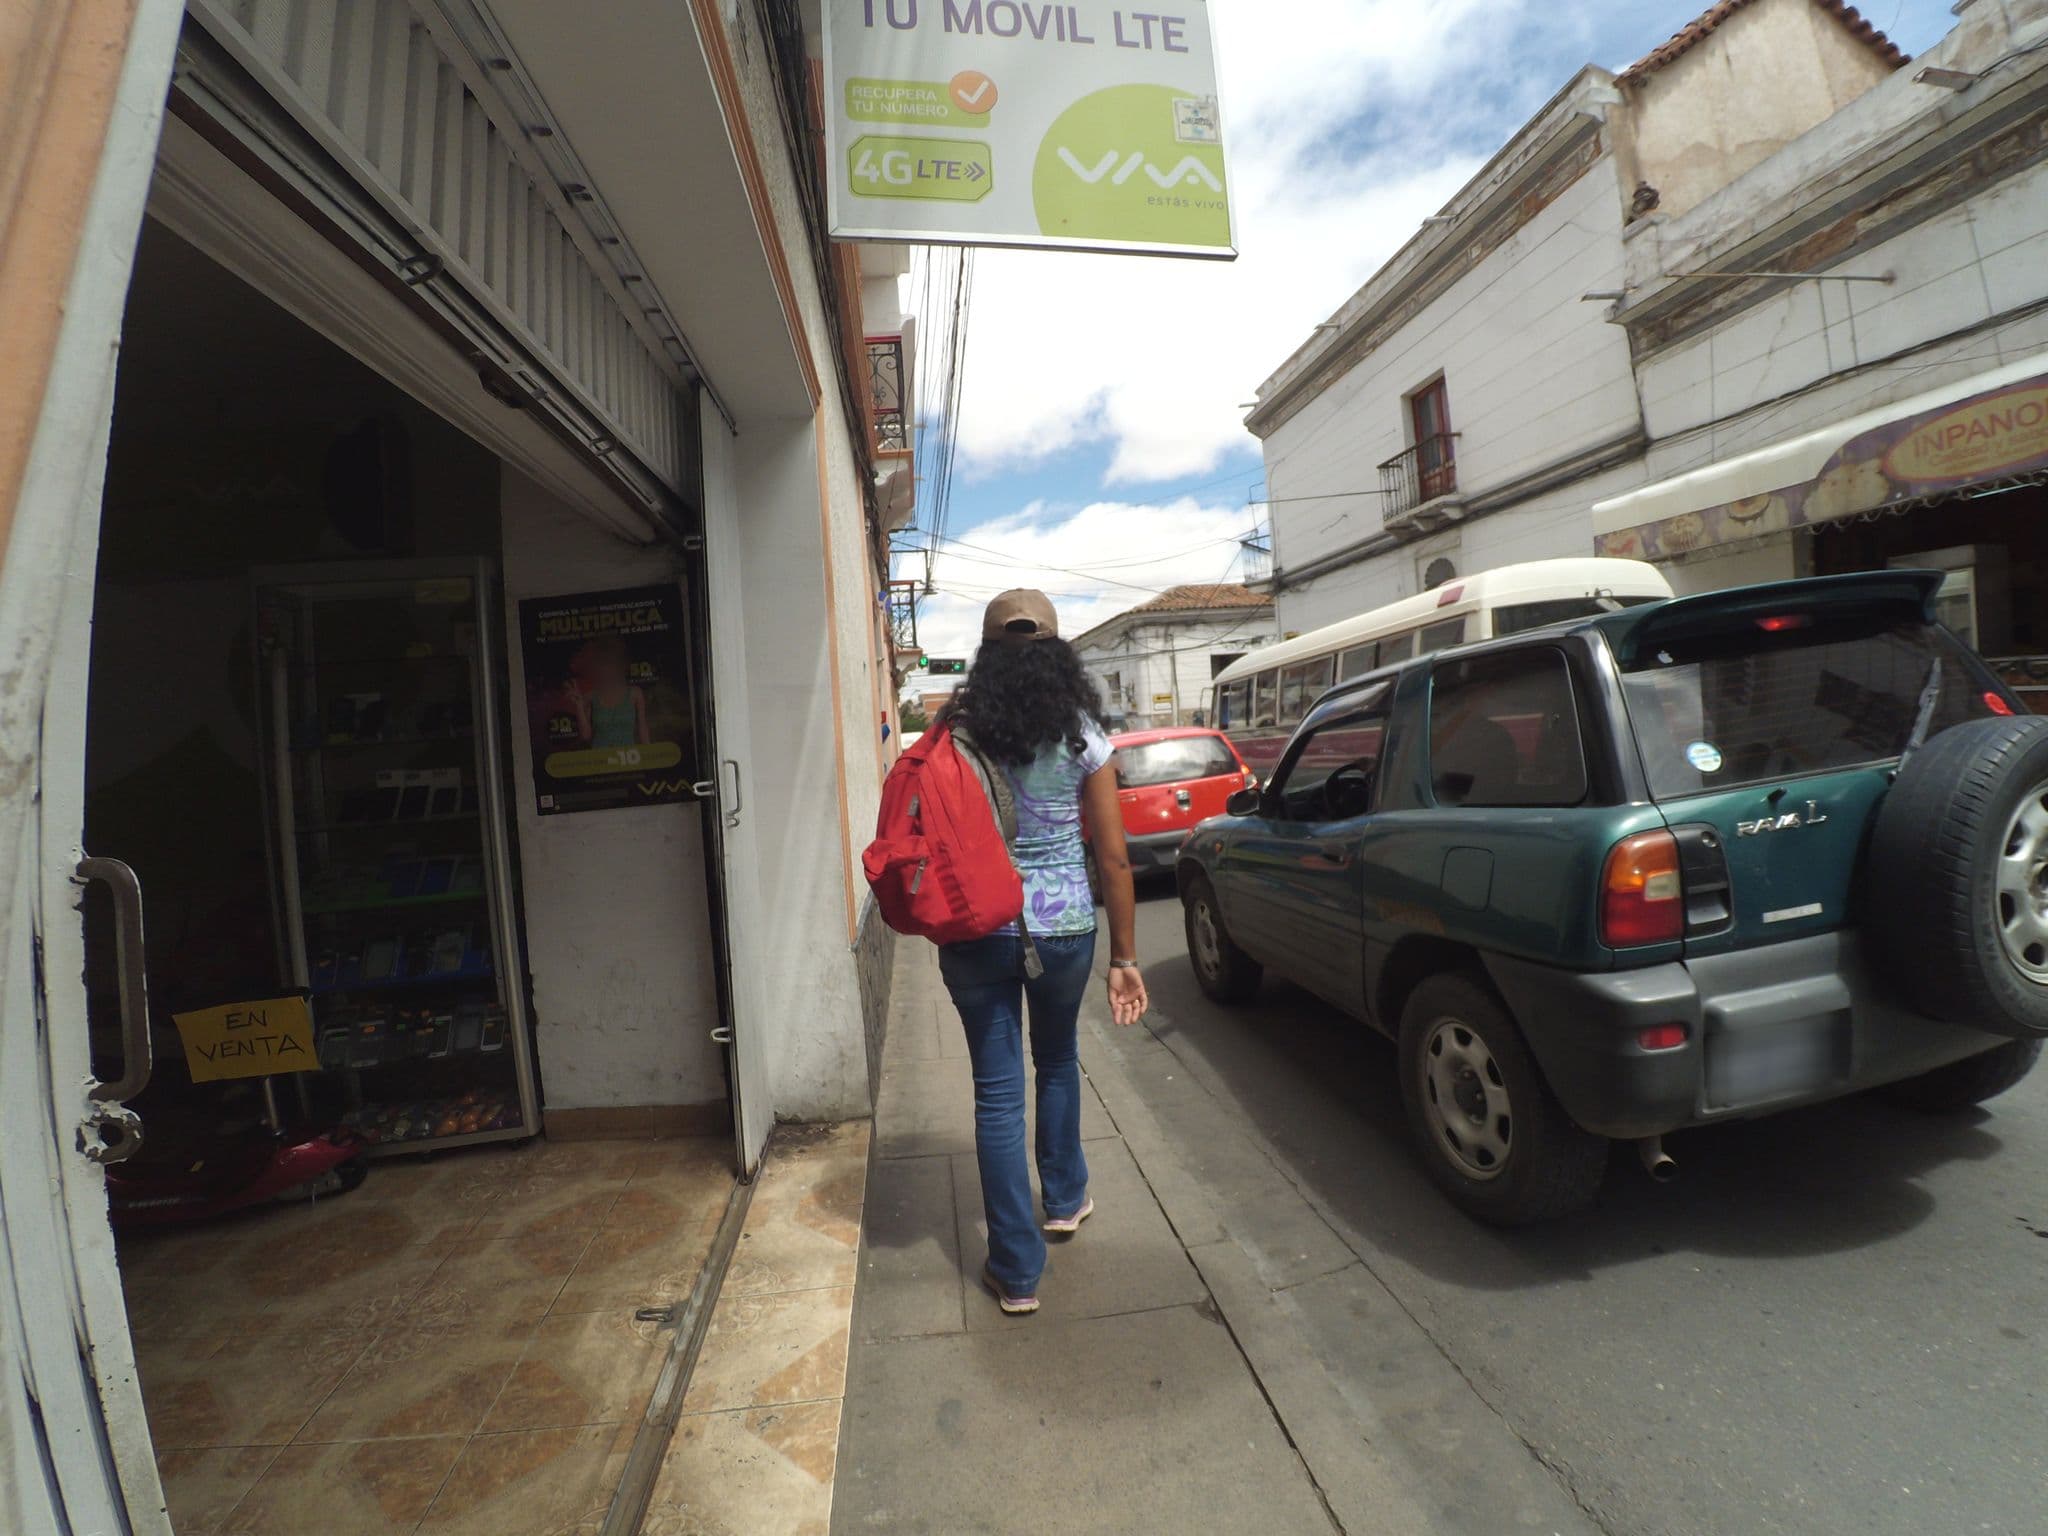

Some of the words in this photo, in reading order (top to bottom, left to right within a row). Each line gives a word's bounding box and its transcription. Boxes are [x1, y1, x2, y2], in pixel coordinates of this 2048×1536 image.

[864, 0, 917, 30] TU
[1114, 11, 1189, 53] LTE
[852, 86, 937, 101] RECUPERA
[855, 101, 874, 113] TU
[854, 149, 913, 185] 4G
[917, 159, 962, 180] LTE
[1057, 146, 1222, 193] VIVA
[1194, 199, 1226, 211] vivo
[1914, 397, 2048, 458] INPANO
[540, 607, 663, 635] MULTIPLICA
[225, 1010, 269, 1030] EN
[196, 1034, 306, 1062] VENTA
